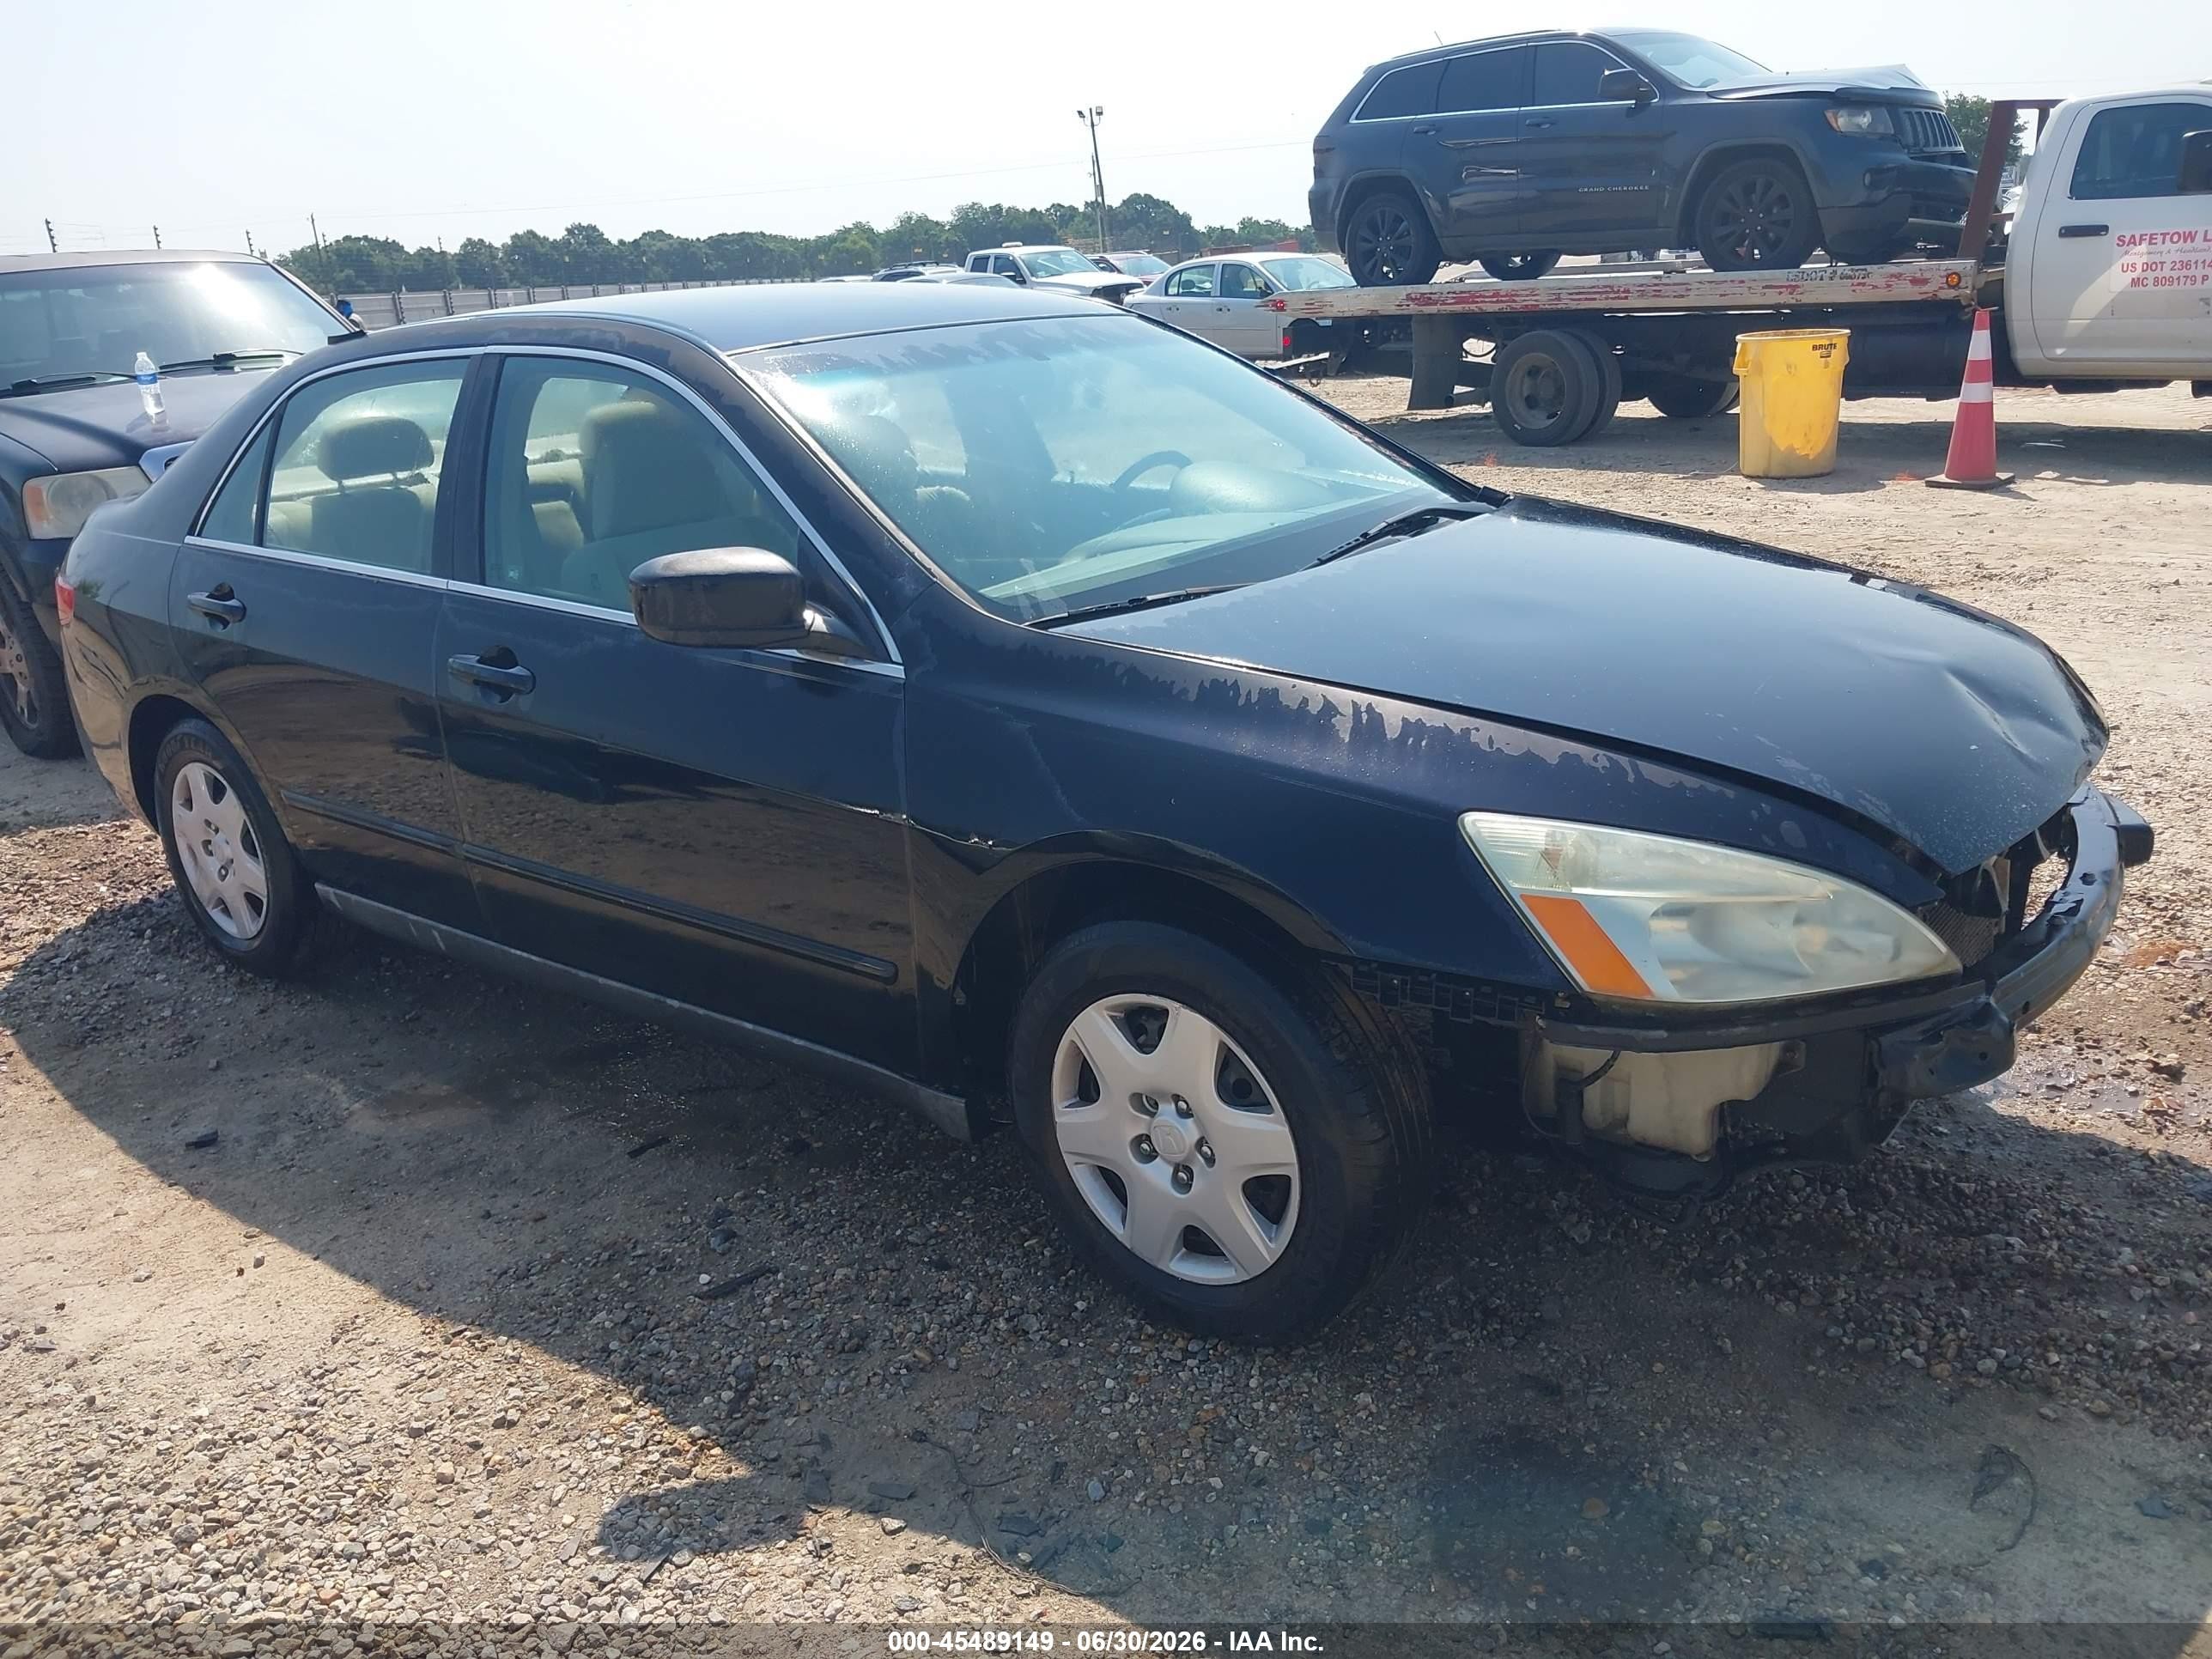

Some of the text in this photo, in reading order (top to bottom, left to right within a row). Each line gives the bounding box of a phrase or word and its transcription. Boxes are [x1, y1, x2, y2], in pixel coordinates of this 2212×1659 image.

[2116, 230, 2198, 247] SAFETOW
[2121, 263, 2137, 273] US
[2142, 261, 2166, 272] DOT
[2130, 276, 2148, 288] MC
[2153, 275, 2197, 287] 809179
